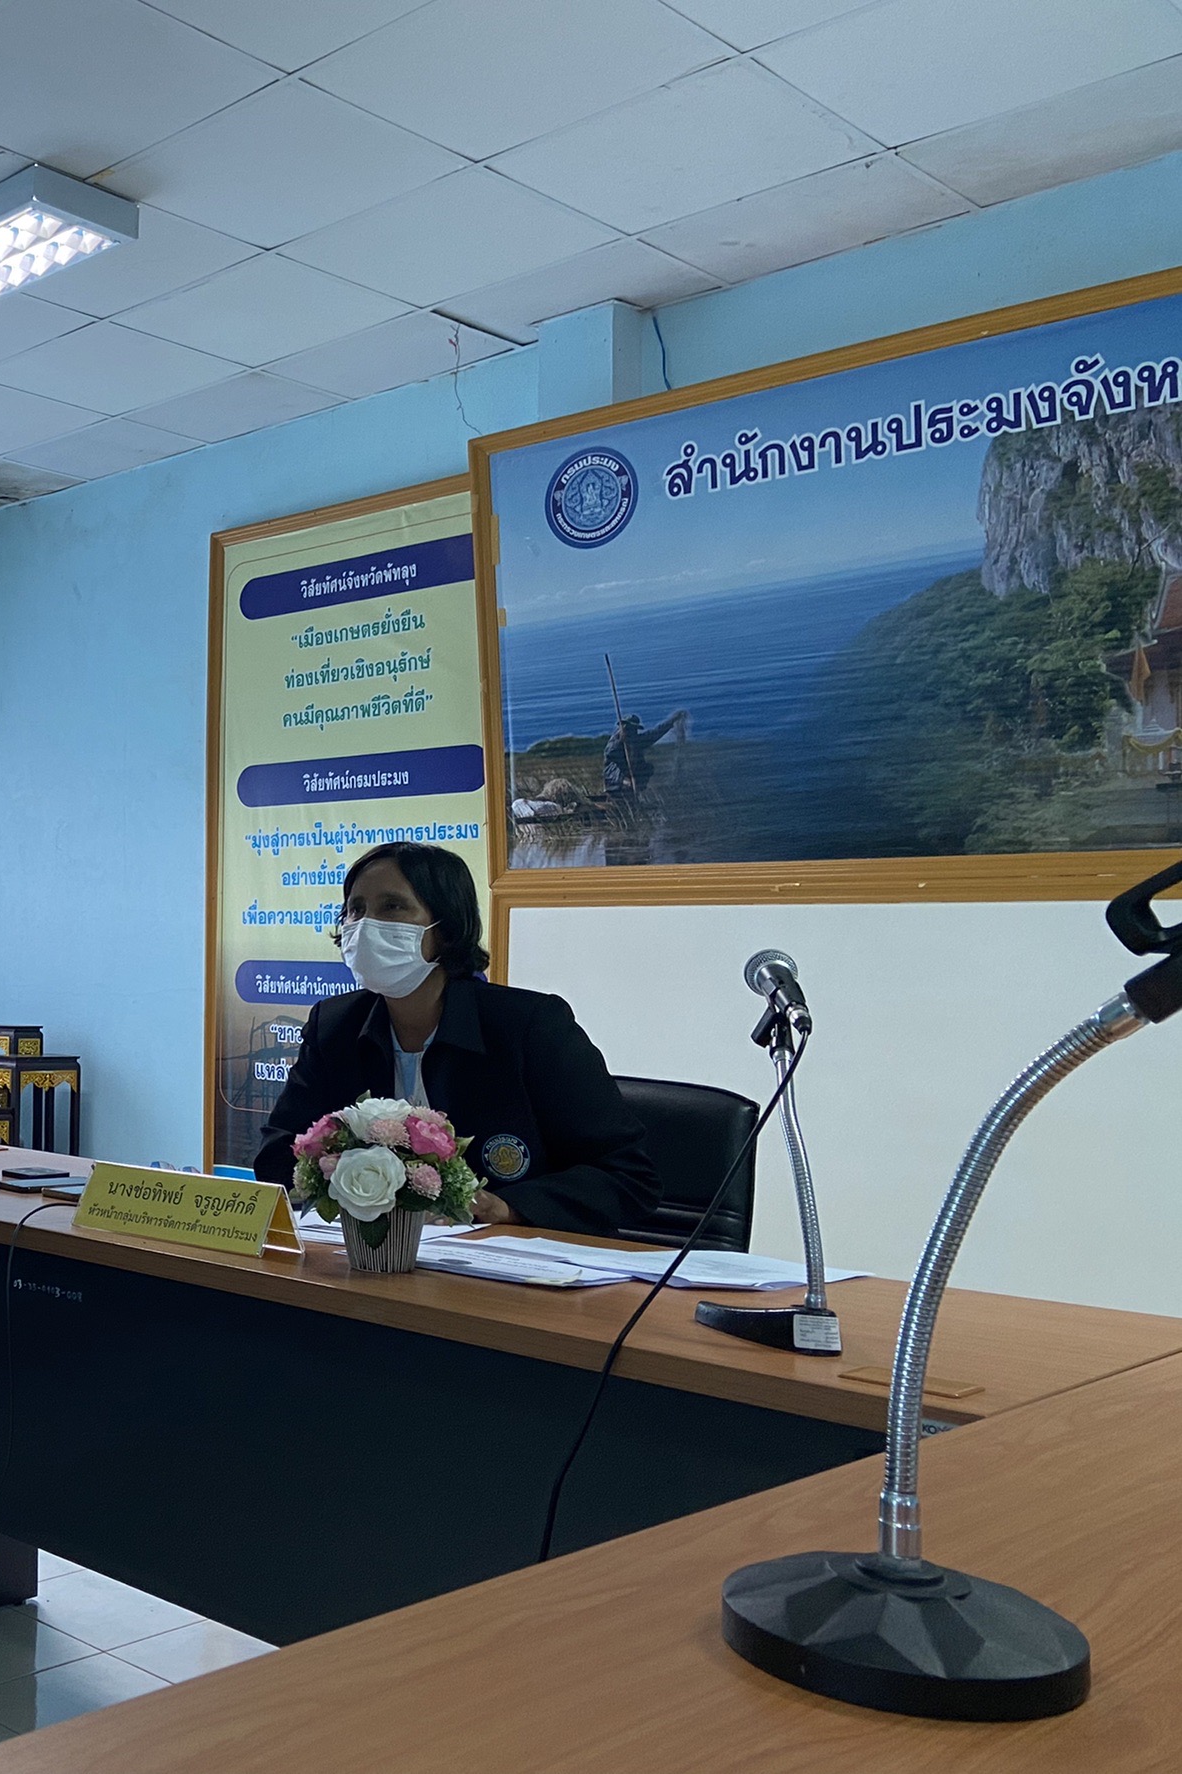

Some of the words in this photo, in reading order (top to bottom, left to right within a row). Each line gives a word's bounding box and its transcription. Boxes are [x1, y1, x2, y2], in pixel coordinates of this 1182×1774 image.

[665, 354, 1181, 500] สำนักงานประมงจังห
[560, 455, 620, 484] กรมประมง
[300, 562, 417, 600] วิสัยทัศน์จังหวัดพัทลุง
[290, 608, 426, 649] “เมืองเกษตรยั่งยืน
[284, 648, 432, 689] ท่องเที่ยวเชิงอนุรักษ์
[282, 686, 434, 732] คนมีคุณภาพชีวิตที่ดี”
[302, 767, 410, 794] วิสัยทัศน์กรมประมง
[245, 822, 479, 856] “มุ่งสู่การเป็นผู้นำทางการประมง
[108, 1179, 186, 1206] นางช่อทิพย์
[194, 1189, 261, 1217] จรูญศักดิ์
[88, 1202, 258, 1243] หัวหน้ากลุ่มบริหารจัดการด้านการประมง
